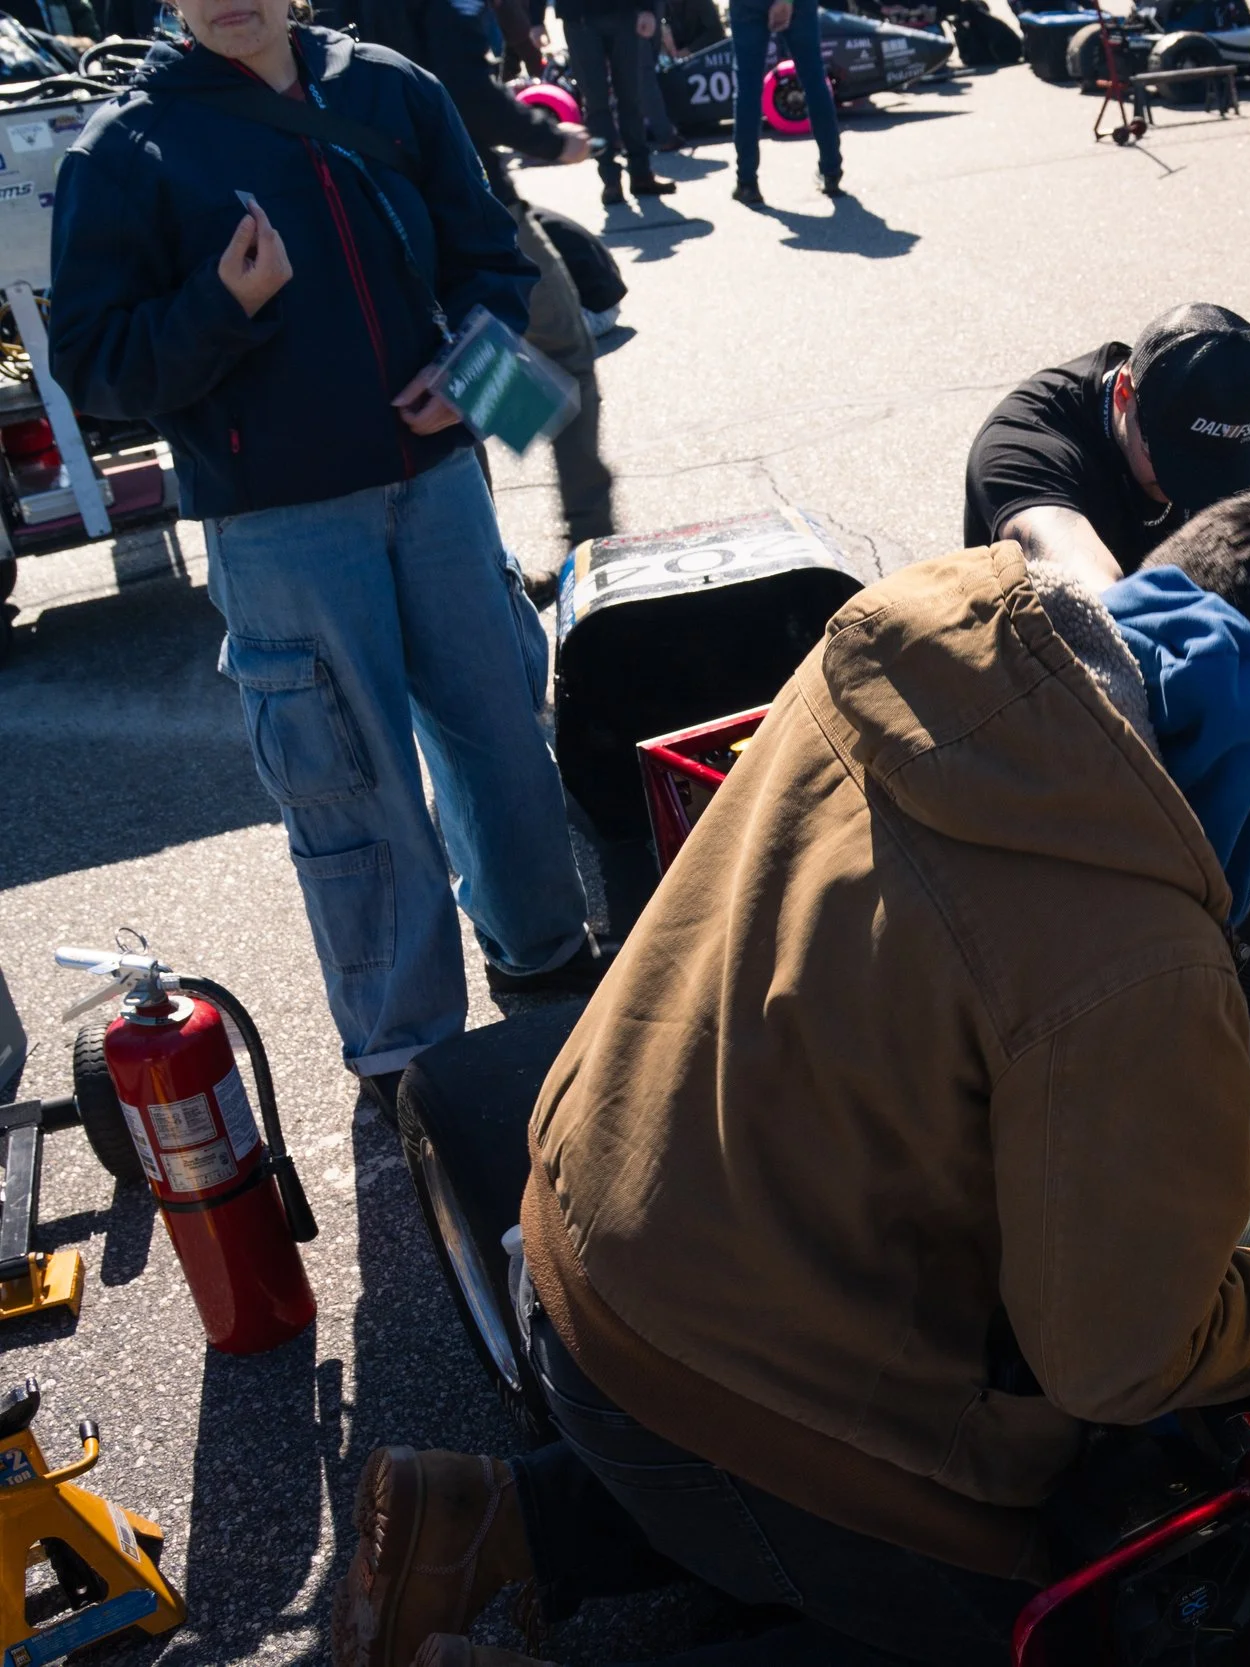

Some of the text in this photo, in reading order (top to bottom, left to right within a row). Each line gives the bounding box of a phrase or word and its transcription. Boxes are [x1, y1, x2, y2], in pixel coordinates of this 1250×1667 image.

[687, 71, 738, 105] 20
[5, 1448, 28, 1472] 2
[5, 1470, 32, 1485] Ton
